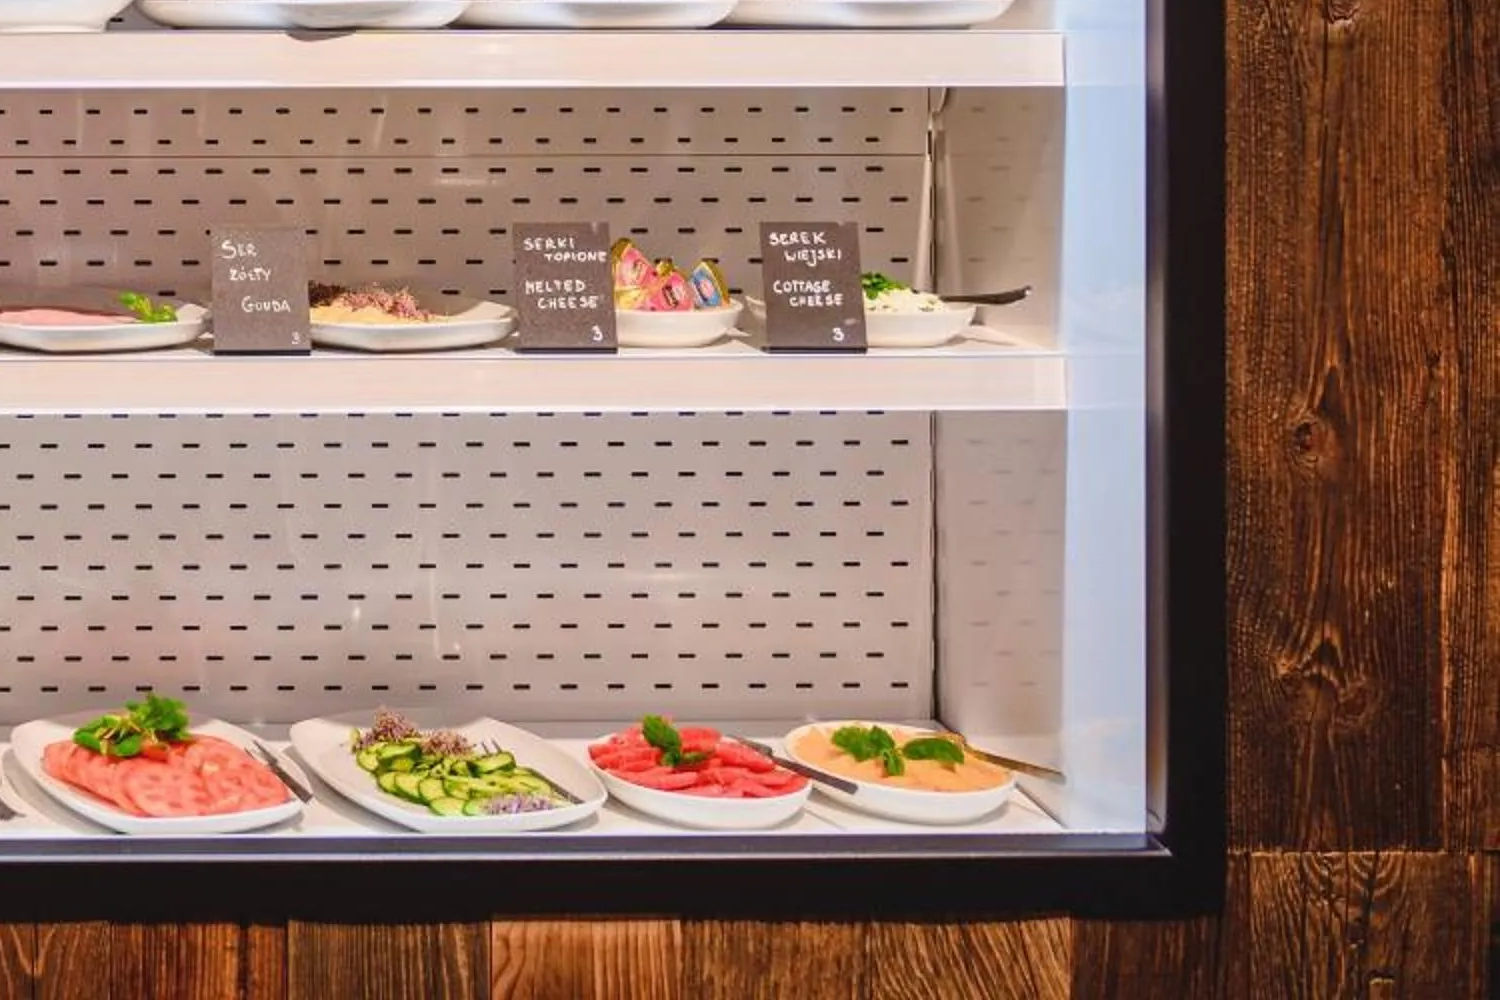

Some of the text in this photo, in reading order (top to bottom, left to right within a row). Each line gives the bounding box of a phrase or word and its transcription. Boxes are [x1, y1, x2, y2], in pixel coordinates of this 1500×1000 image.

[523, 237, 575, 251] SERKI
[768, 231, 827, 246] SEREK
[221, 240, 257, 259] SER
[543, 251, 607, 262] TOPIONE
[784, 248, 842, 267] WIEJSKI
[525, 280, 587, 295] MELTED
[773, 280, 831, 294] COTTAGE
[241, 295, 291, 313] GOUDA
[537, 295, 599, 309] CHEESE
[790, 294, 844, 307] CHEESE
[591, 324, 603, 341] 3
